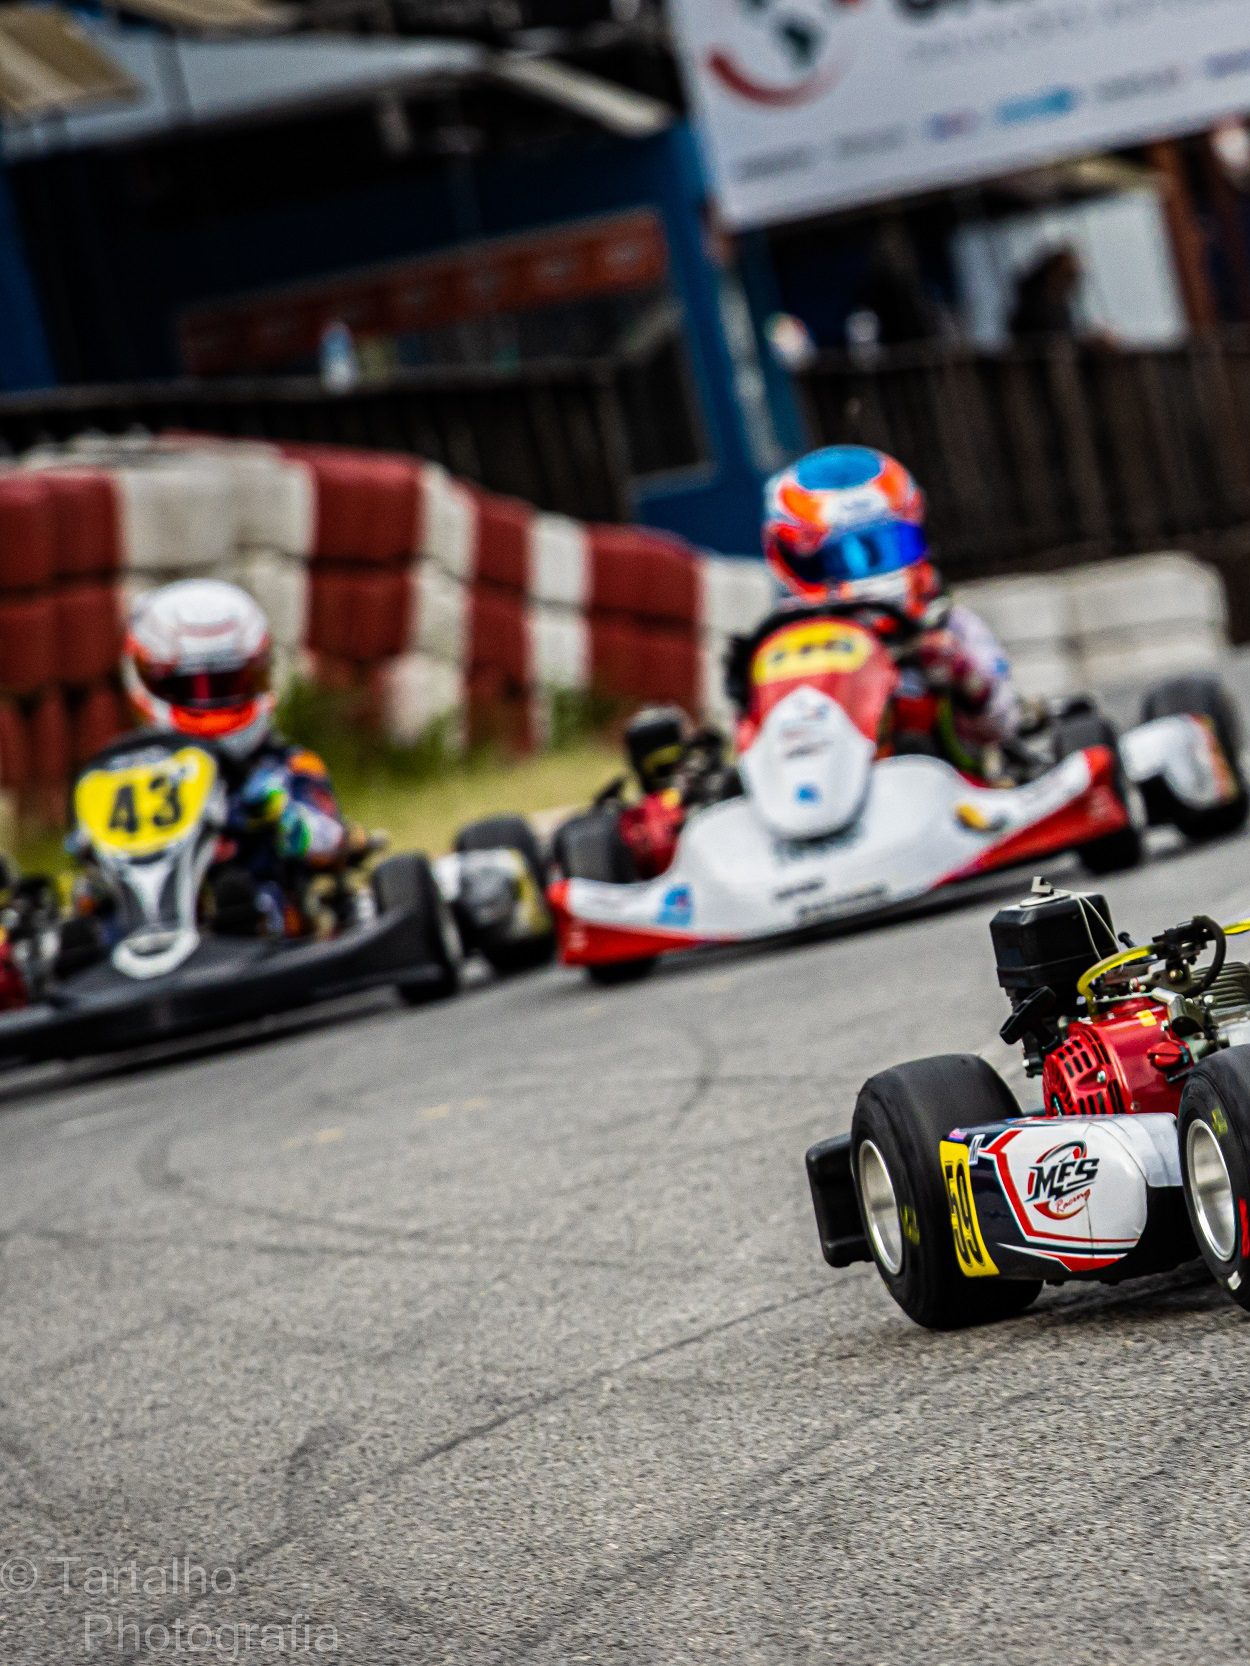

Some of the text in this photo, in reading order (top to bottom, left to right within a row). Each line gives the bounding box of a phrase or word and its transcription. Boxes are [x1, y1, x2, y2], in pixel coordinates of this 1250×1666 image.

[108, 773, 182, 834] 43
[1024, 1158, 1099, 1202] MFS
[1055, 1188, 1091, 1214] Racing
